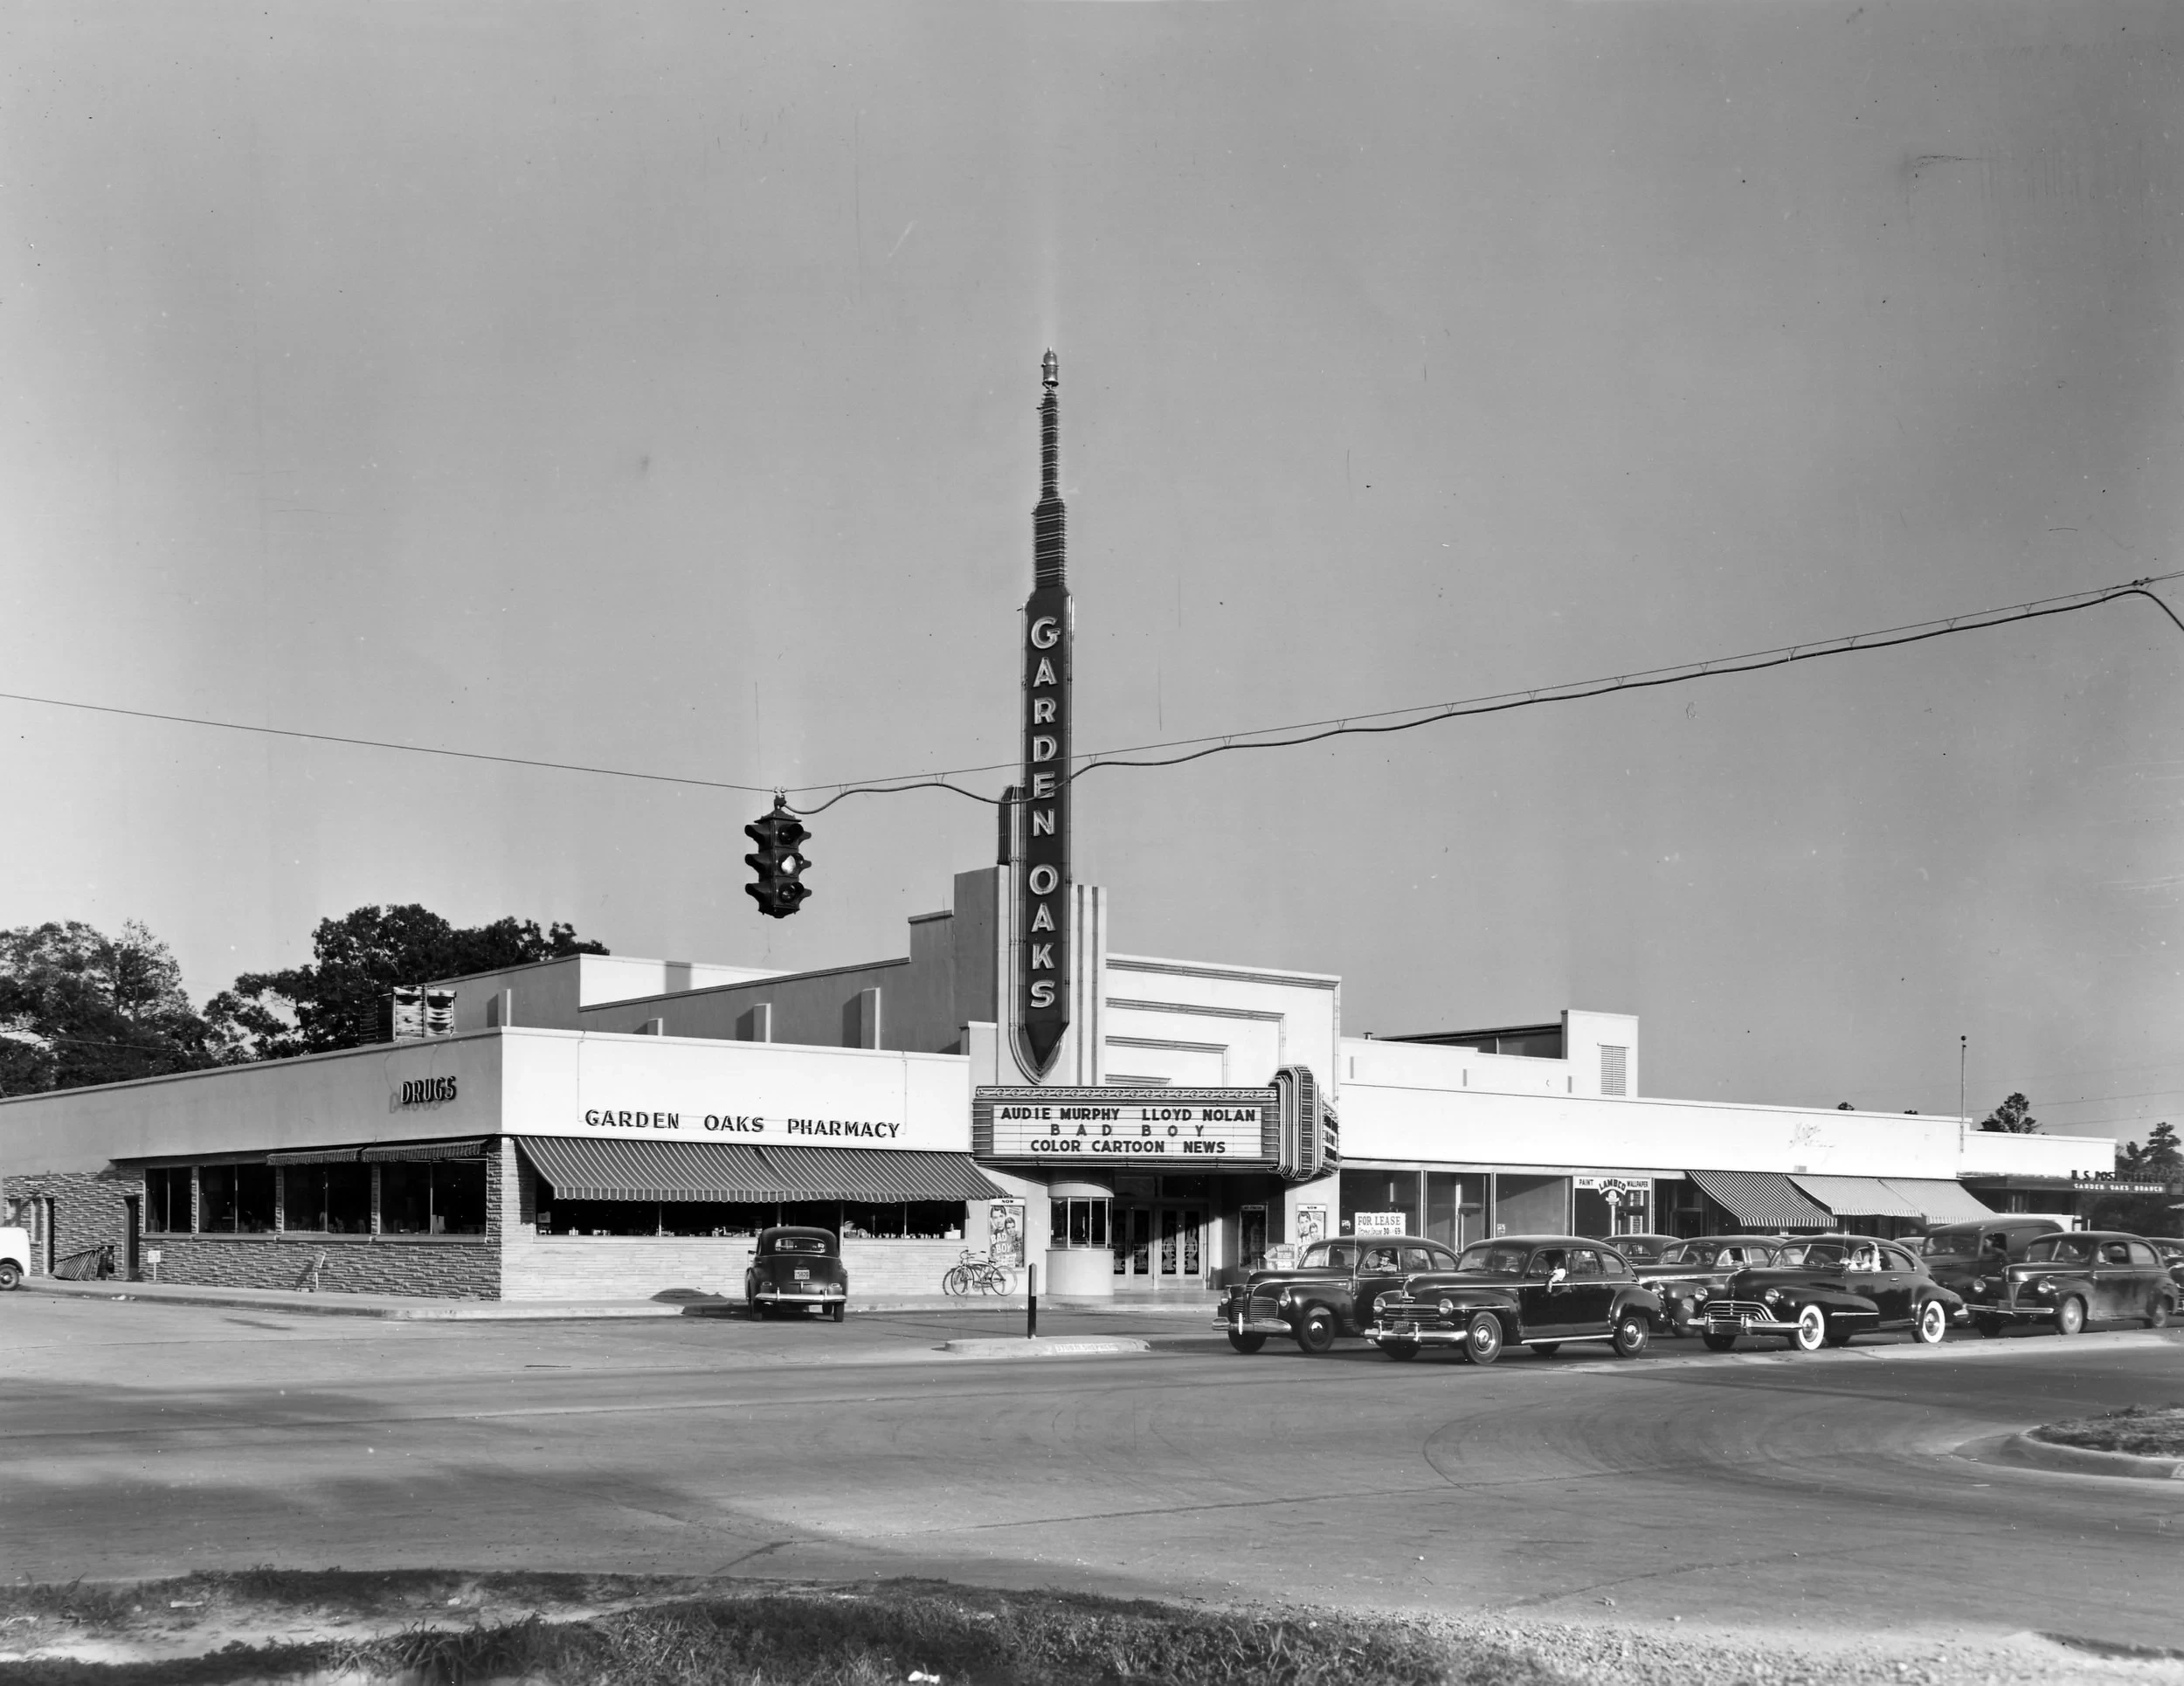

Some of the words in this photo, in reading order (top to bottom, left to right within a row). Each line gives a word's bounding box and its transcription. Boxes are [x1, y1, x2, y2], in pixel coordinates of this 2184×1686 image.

[1031, 616, 1061, 837] GARDEN
[1029, 863, 1059, 1007] OAKS
[401, 1075, 457, 1104] DRUGS
[1001, 1107, 1051, 1120] AUDIE
[1060, 1108, 1120, 1121] MURPHY
[1142, 1109, 1192, 1121] LLOYD
[1202, 1109, 1255, 1122] NOLAN
[585, 1109, 680, 1130] GARDEN
[703, 1114, 764, 1133] OAKS
[787, 1118, 900, 1138] PHARMACY
[1050, 1124, 1112, 1137] BAD
[1141, 1124, 1204, 1137] BOY
[1030, 1139, 1081, 1152] COLOR
[1091, 1140, 1165, 1153] CARTOON
[1183, 1141, 1226, 1154] NEWS
[1599, 1178, 1627, 1191] LAMBCO
[1358, 1215, 1372, 1226] FOR
[1375, 1215, 1401, 1226] LEASE
[991, 1232, 1007, 1245] BAD
[996, 1243, 1012, 1254] BOY
